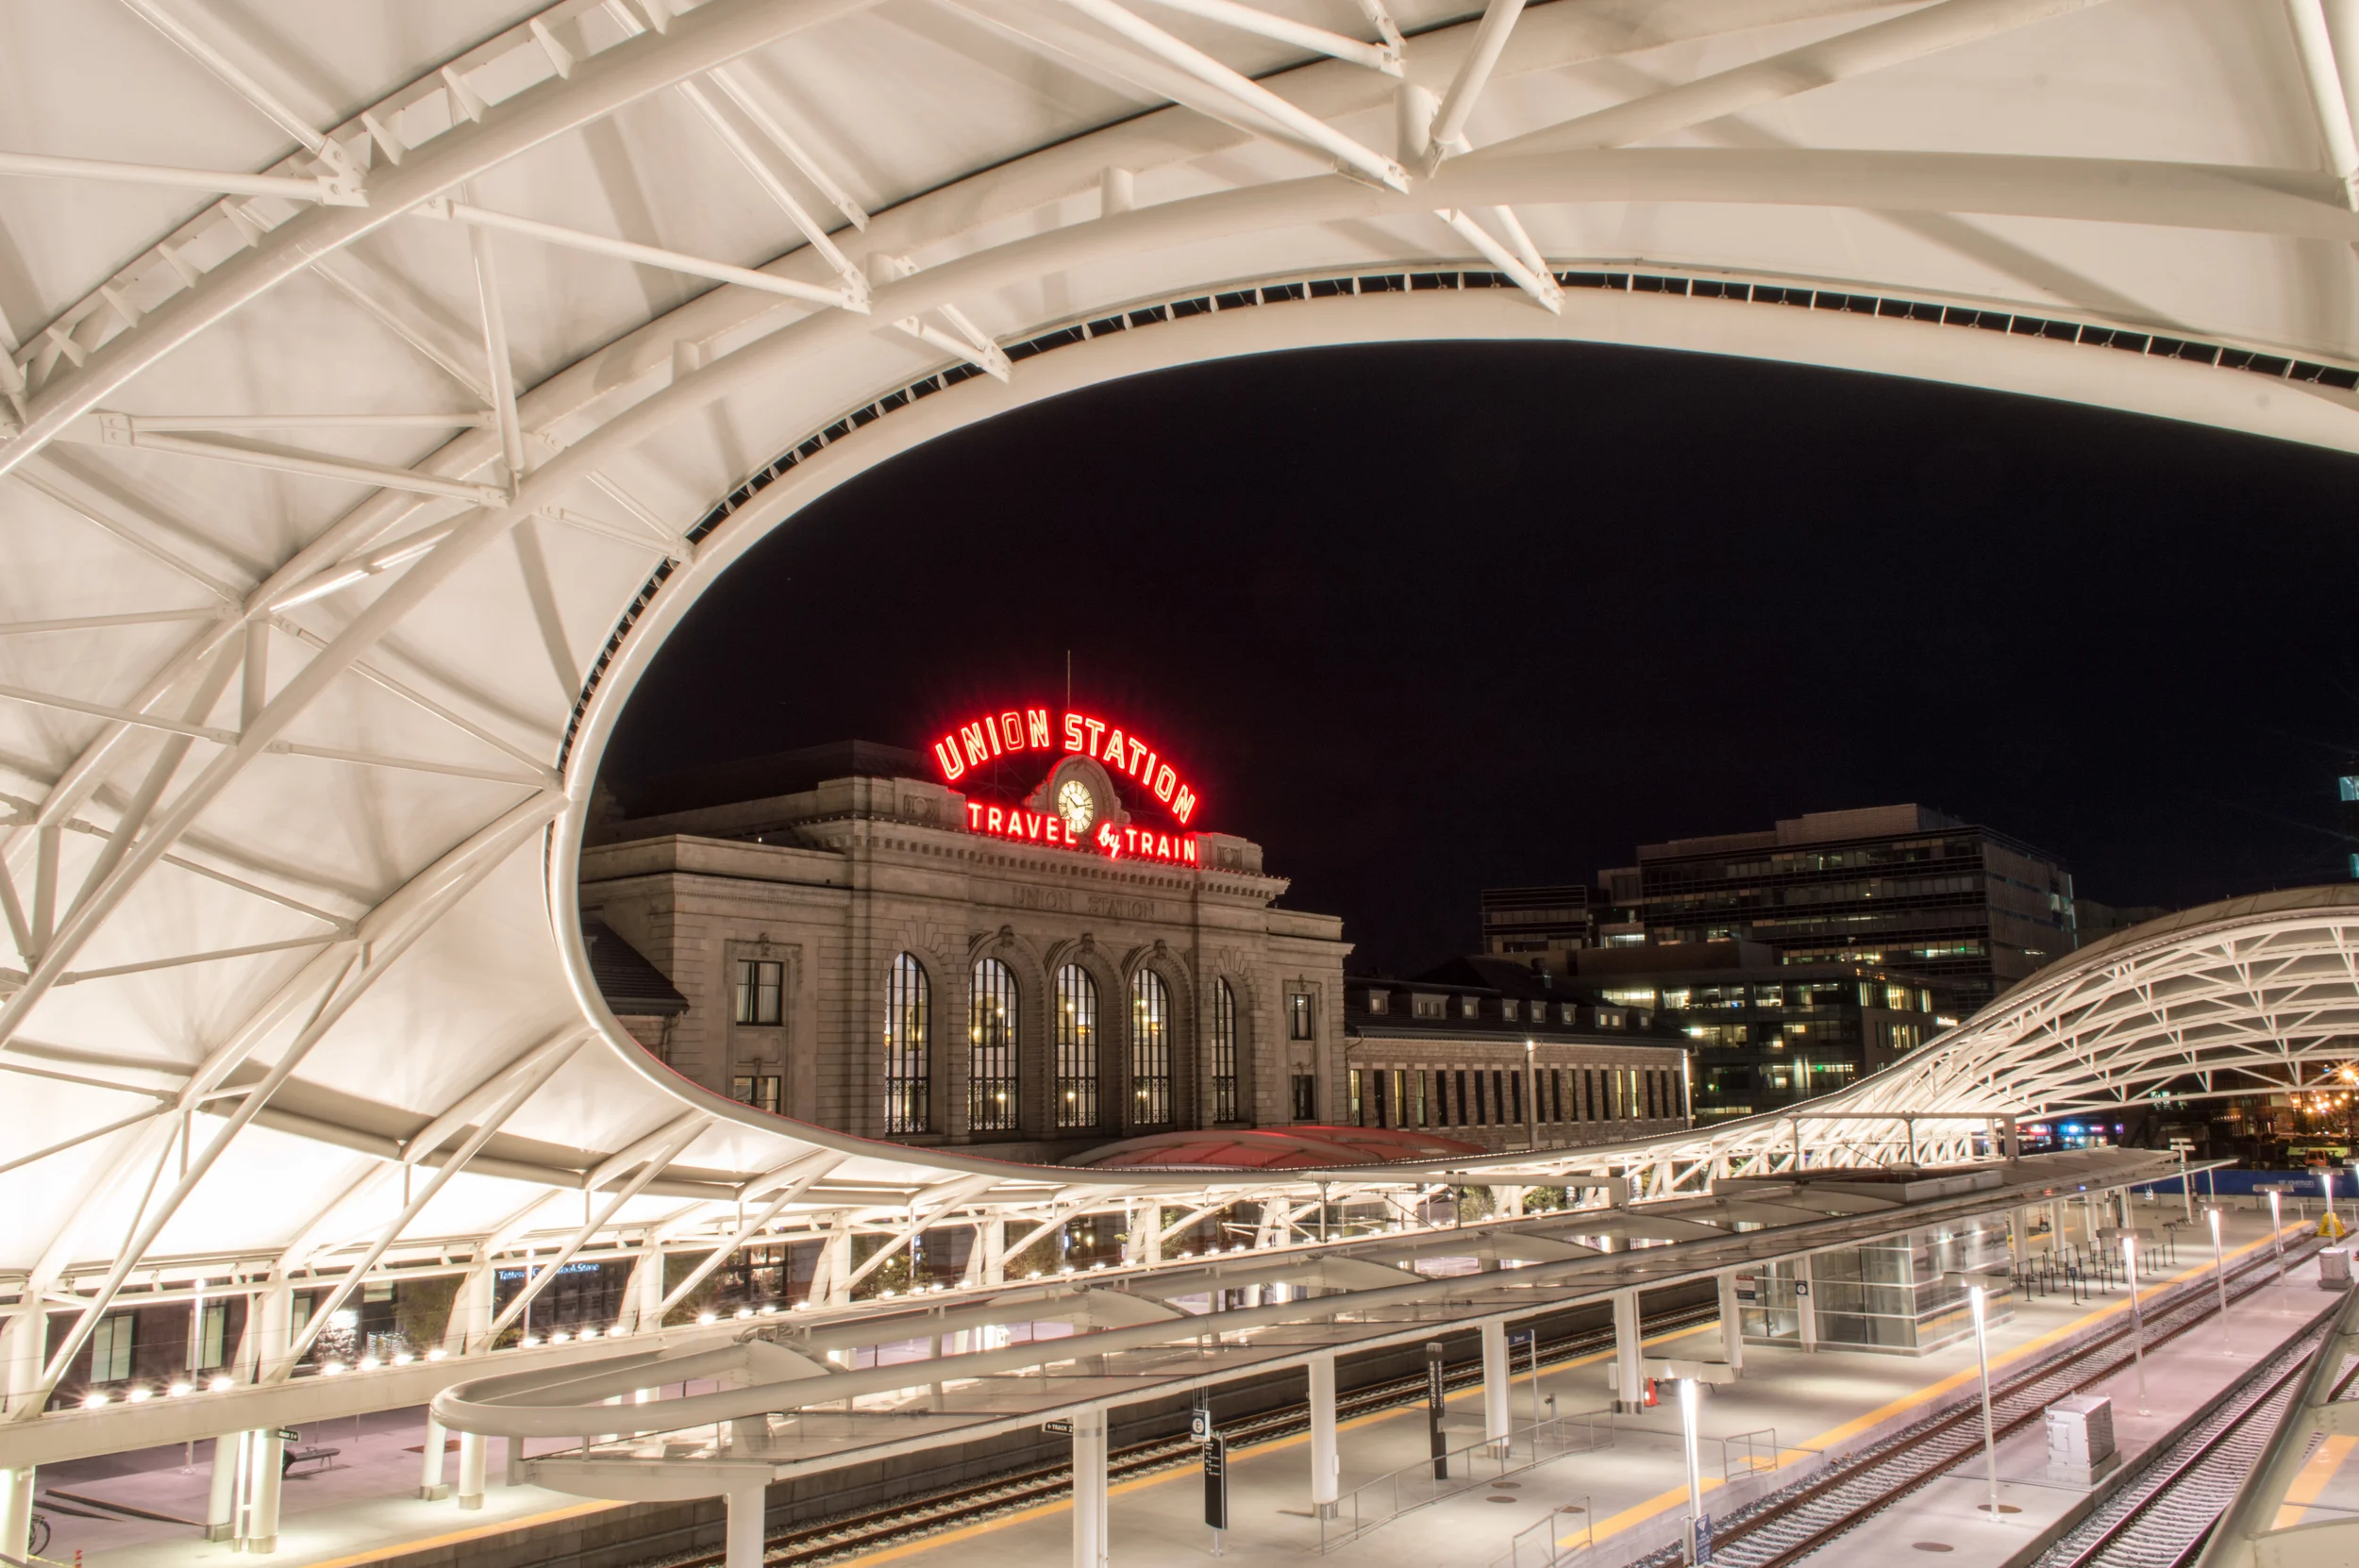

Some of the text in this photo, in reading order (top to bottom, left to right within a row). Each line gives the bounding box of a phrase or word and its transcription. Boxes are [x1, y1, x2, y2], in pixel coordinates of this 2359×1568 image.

[935, 709, 1196, 825] UNION STATION
[967, 802, 1196, 862] TRAVEL by TRAIN
[1012, 887, 1155, 920] UNION STATION
[1196, 1420, 1201, 1430] E
